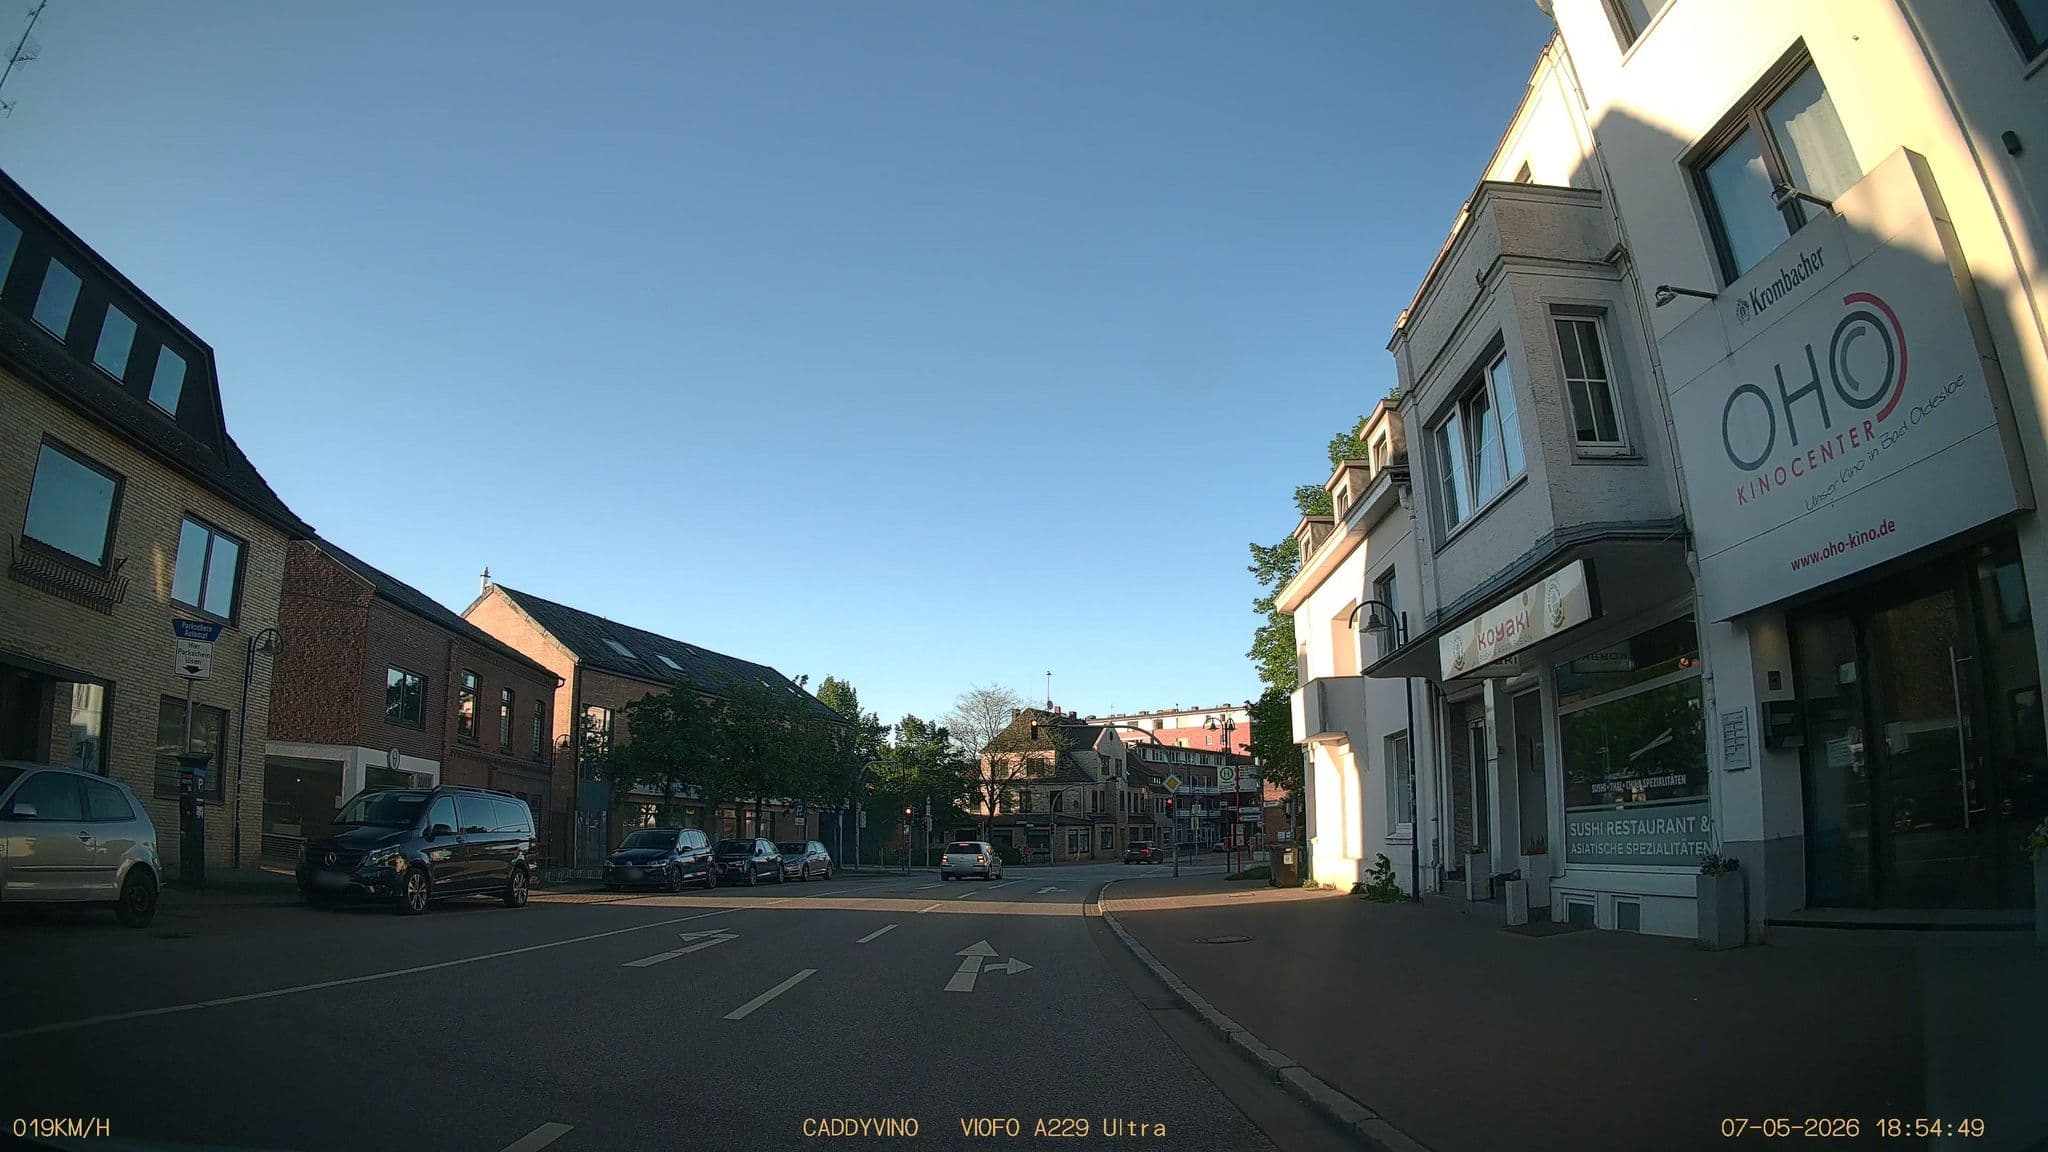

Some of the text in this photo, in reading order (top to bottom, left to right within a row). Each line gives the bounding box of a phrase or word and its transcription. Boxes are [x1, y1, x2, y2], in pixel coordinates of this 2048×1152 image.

[1750, 246, 1825, 315] Krombacher
[1722, 311, 1896, 471] OHO
[1805, 373, 1966, 511] Unser Kino in Bad Oldesloe
[1736, 420, 1876, 505] KINOCENTER
[1791, 518, 1897, 572] www.oho-kino.de
[178, 648, 210, 658] Parkschein
[188, 641, 201, 649] Hier
[198, 778, 204, 790] P
[1592, 783, 1607, 793] SUSHI
[1570, 815, 1711, 836] SUSHI RESTAURANT &
[1571, 841, 1625, 855] ASIATISCHE
